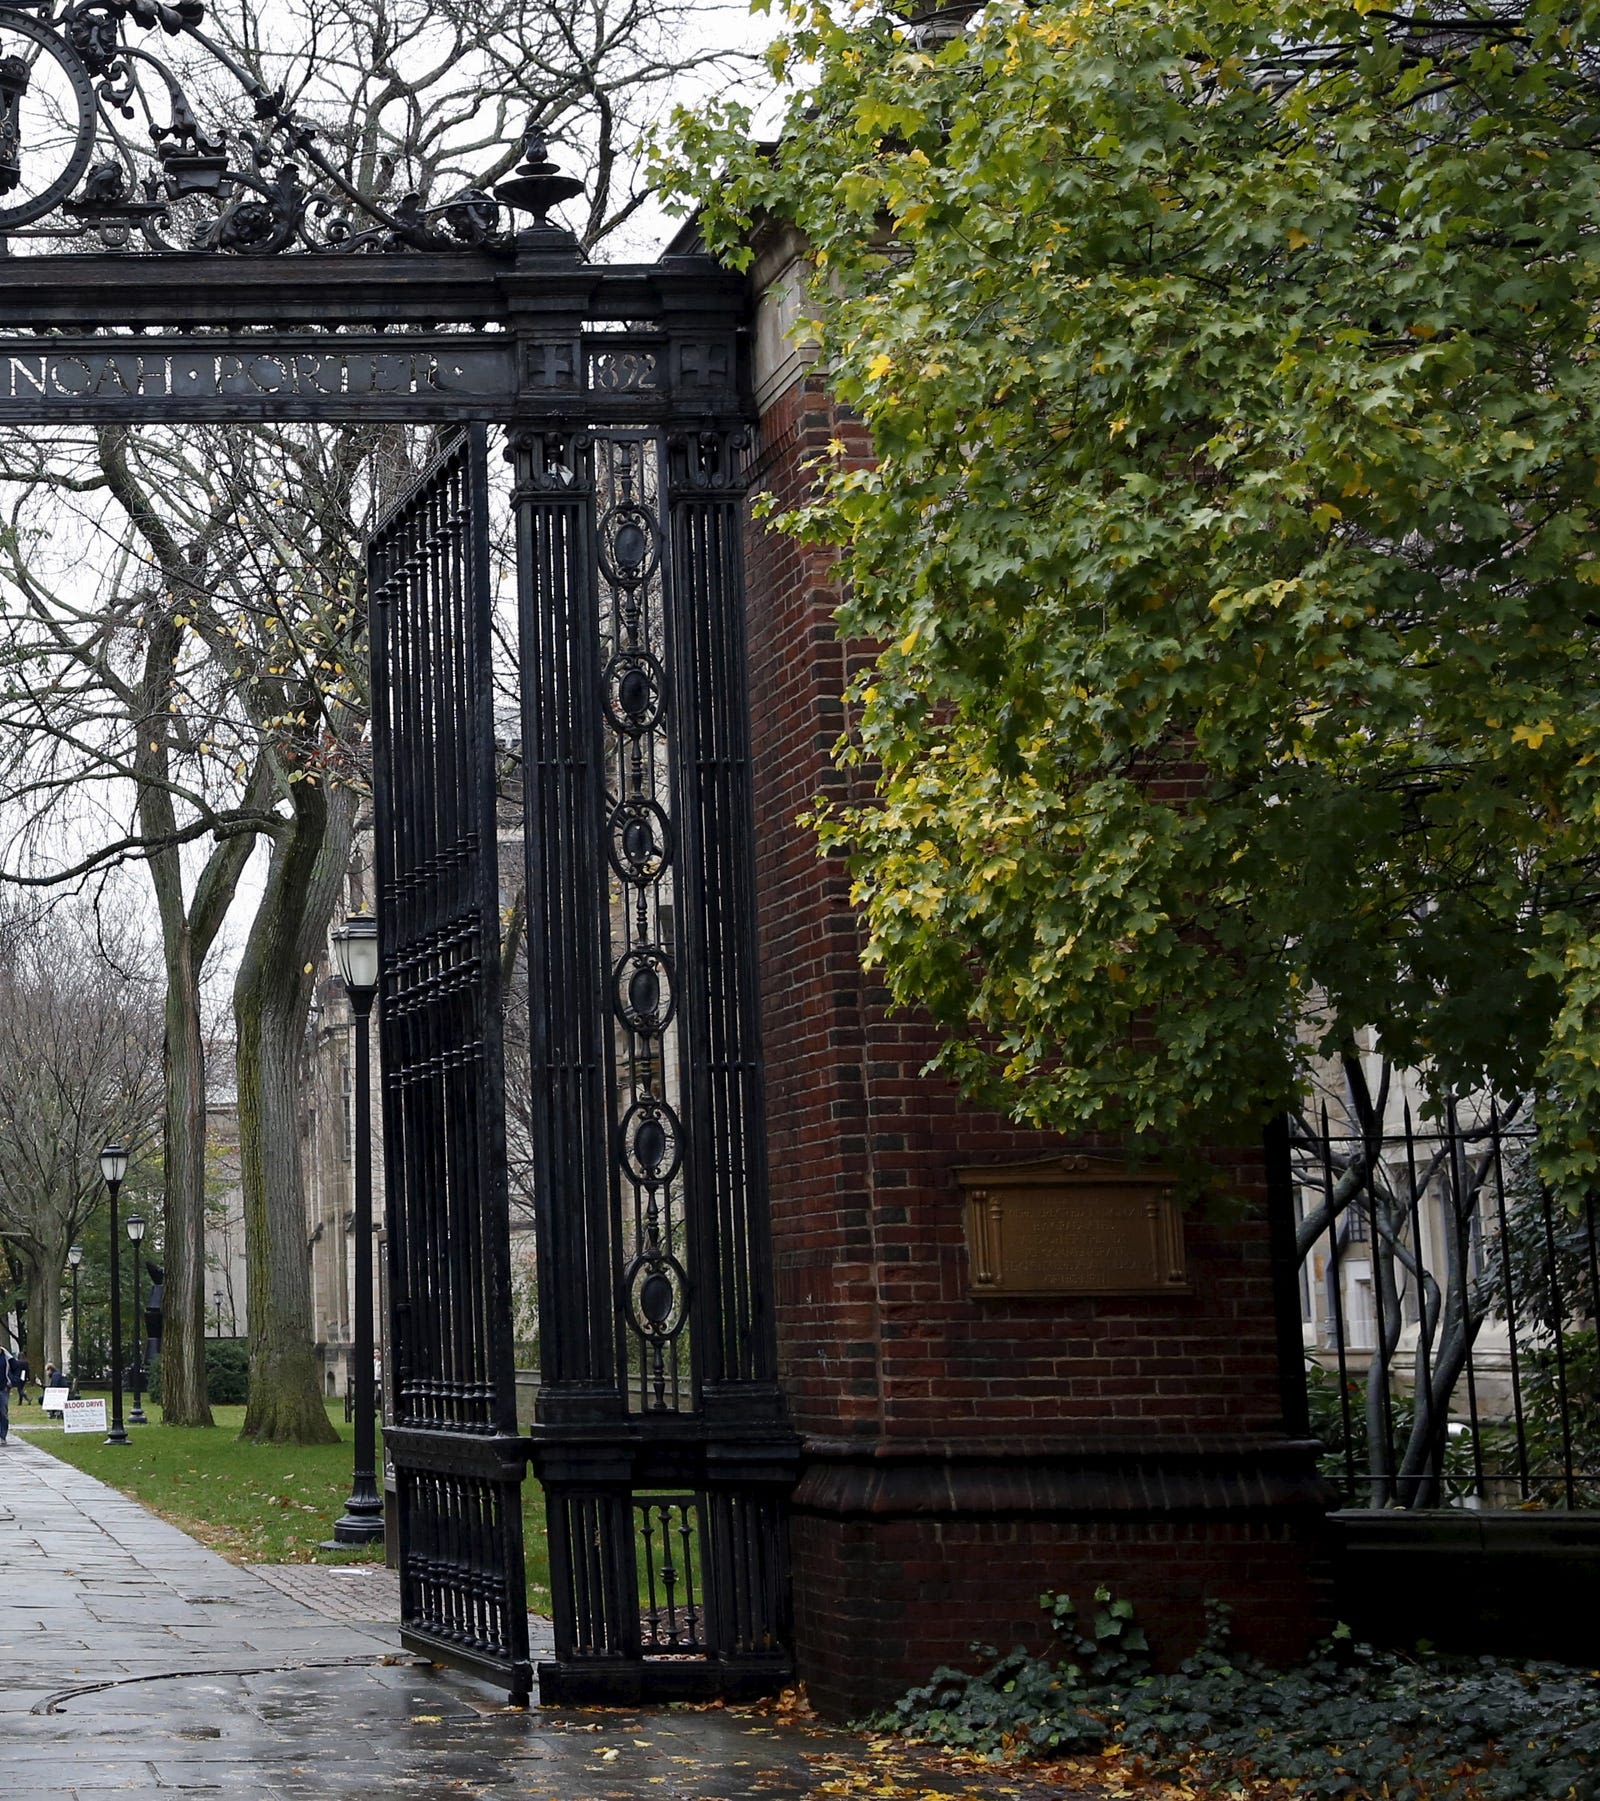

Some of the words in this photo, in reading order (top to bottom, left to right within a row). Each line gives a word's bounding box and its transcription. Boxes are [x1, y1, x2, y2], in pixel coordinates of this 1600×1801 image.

[8, 355, 174, 397] NOAH
[213, 353, 449, 394] PORTER
[587, 354, 657, 391] 1892
[86, 1400, 103, 1408] DRIVE
